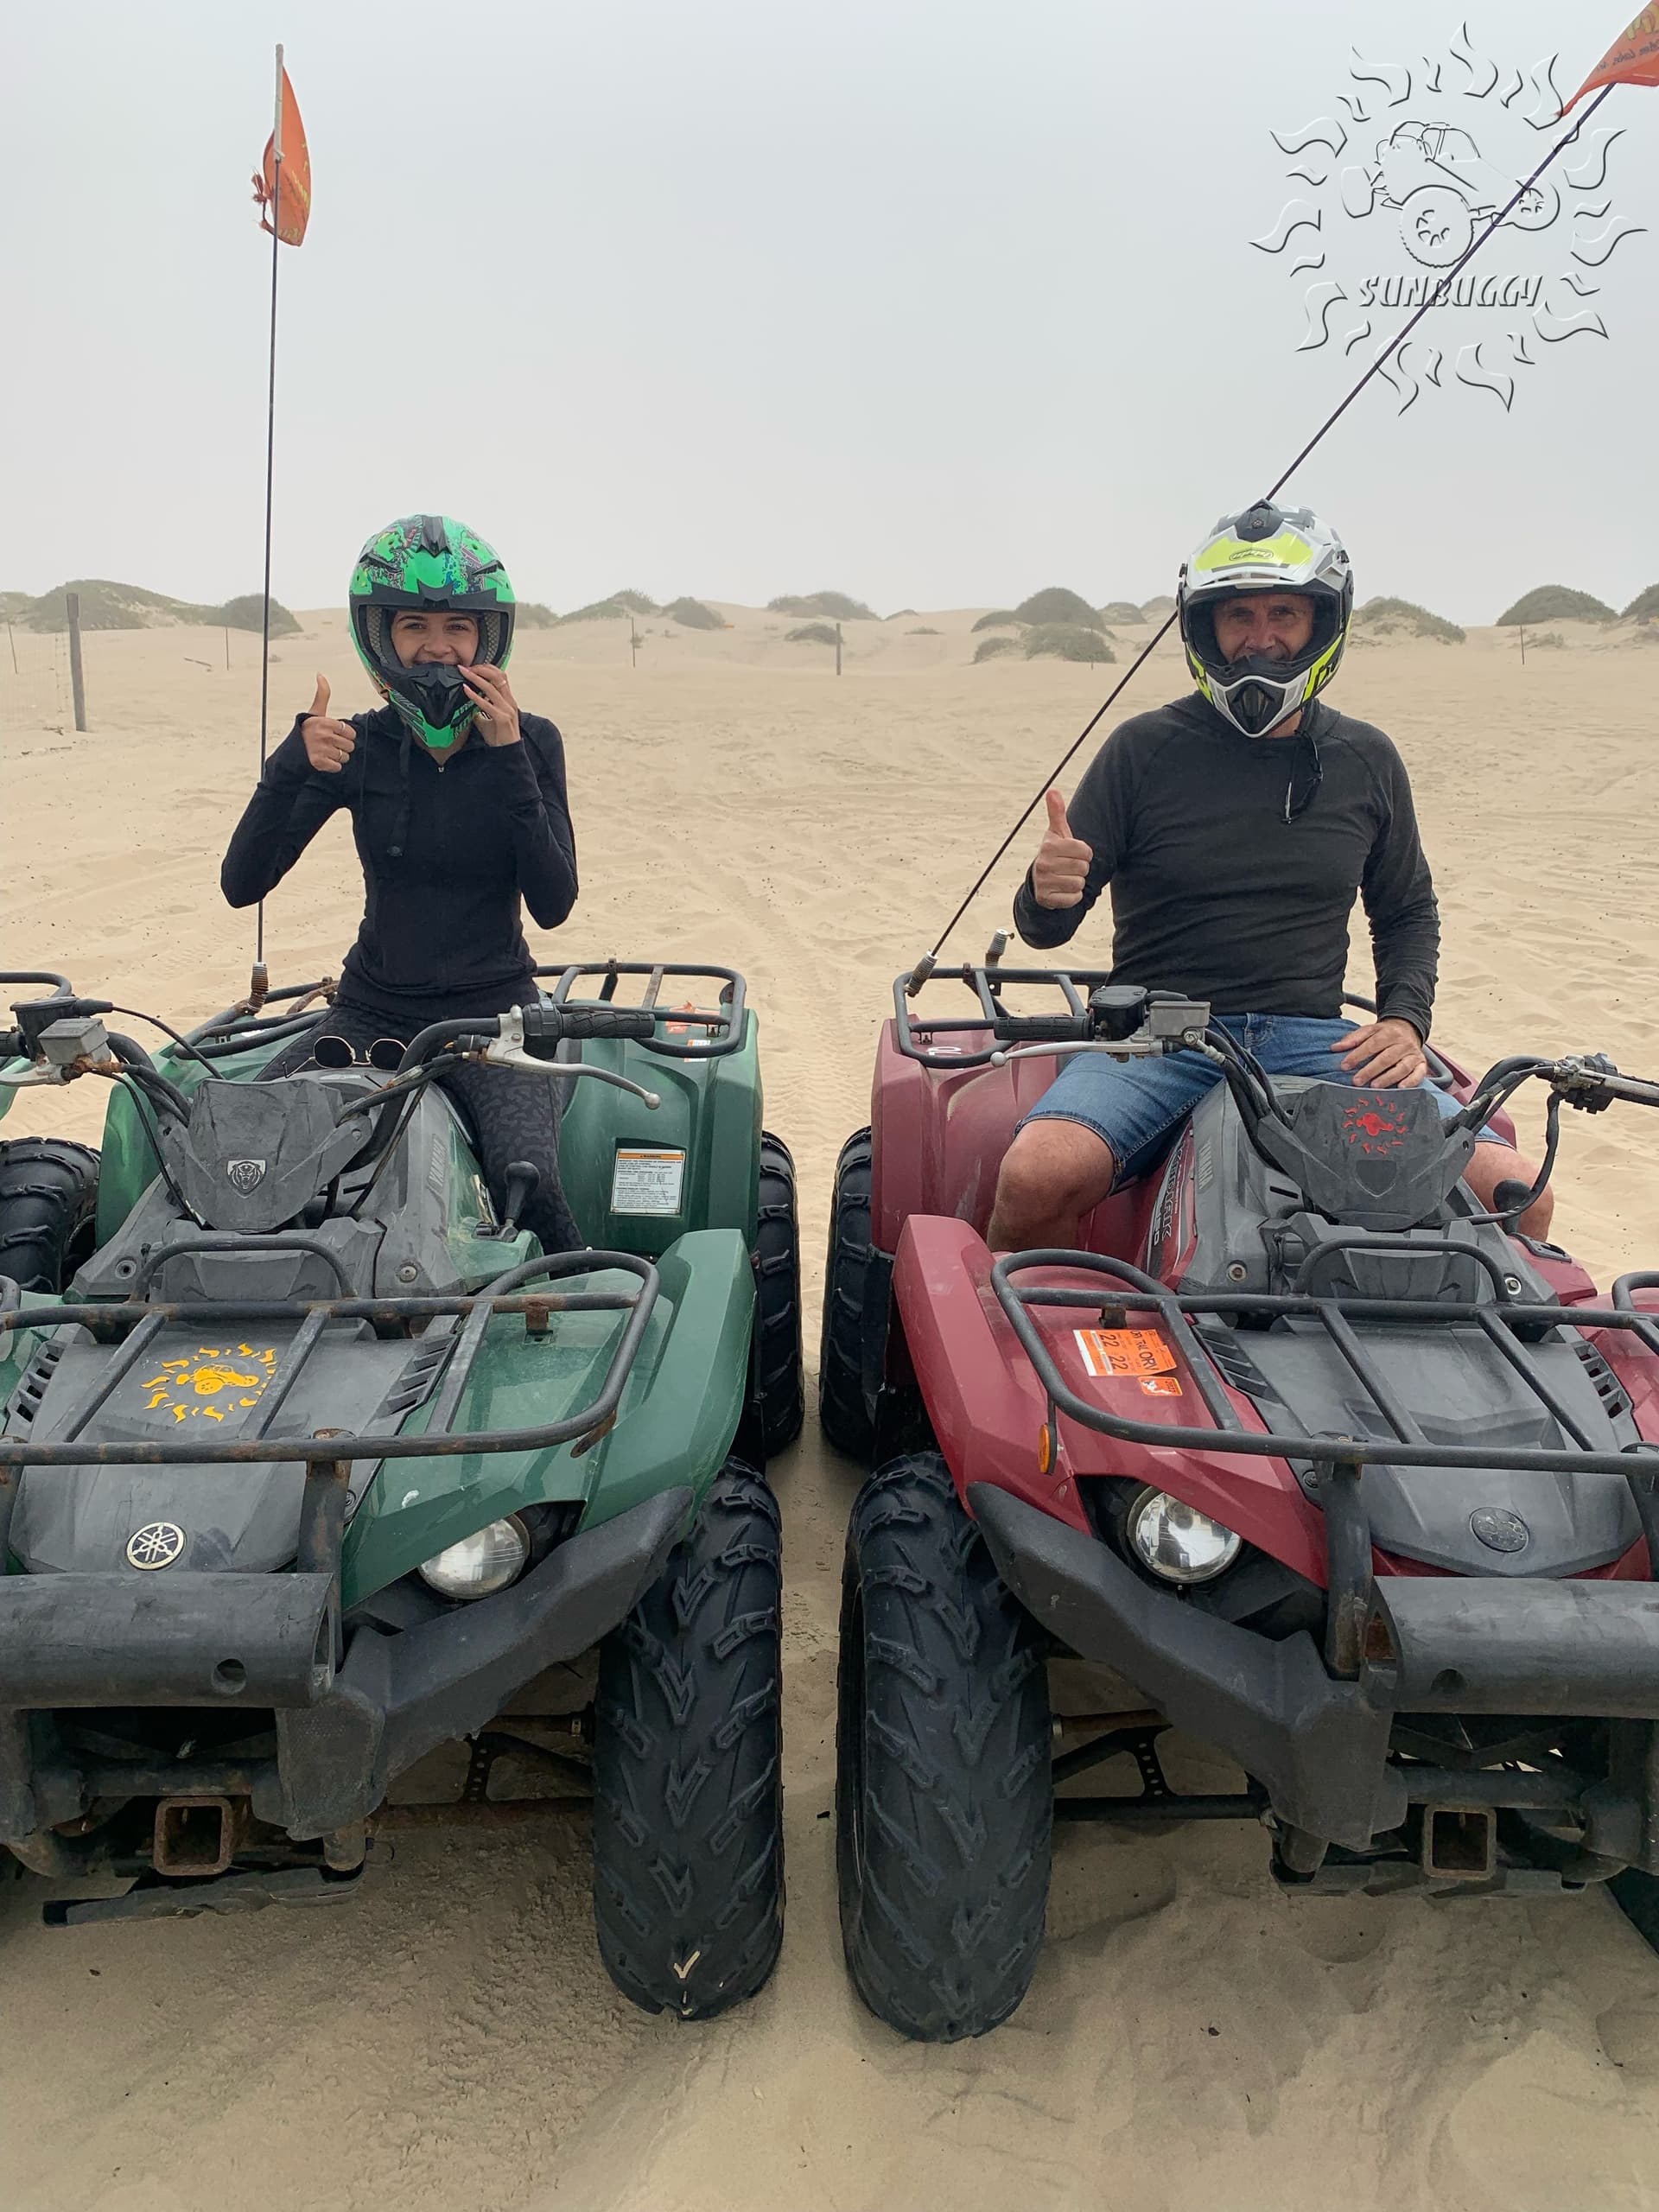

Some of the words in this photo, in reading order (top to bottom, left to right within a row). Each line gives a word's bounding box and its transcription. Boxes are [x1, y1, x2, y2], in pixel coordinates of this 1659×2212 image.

[429, 1139, 446, 1186] YAMAHA
[1198, 1140, 1213, 1190] YAMAHA
[1099, 1334, 1120, 1347] 22
[1108, 1356, 1128, 1370] 22
[1139, 1351, 1159, 1370] ORV
